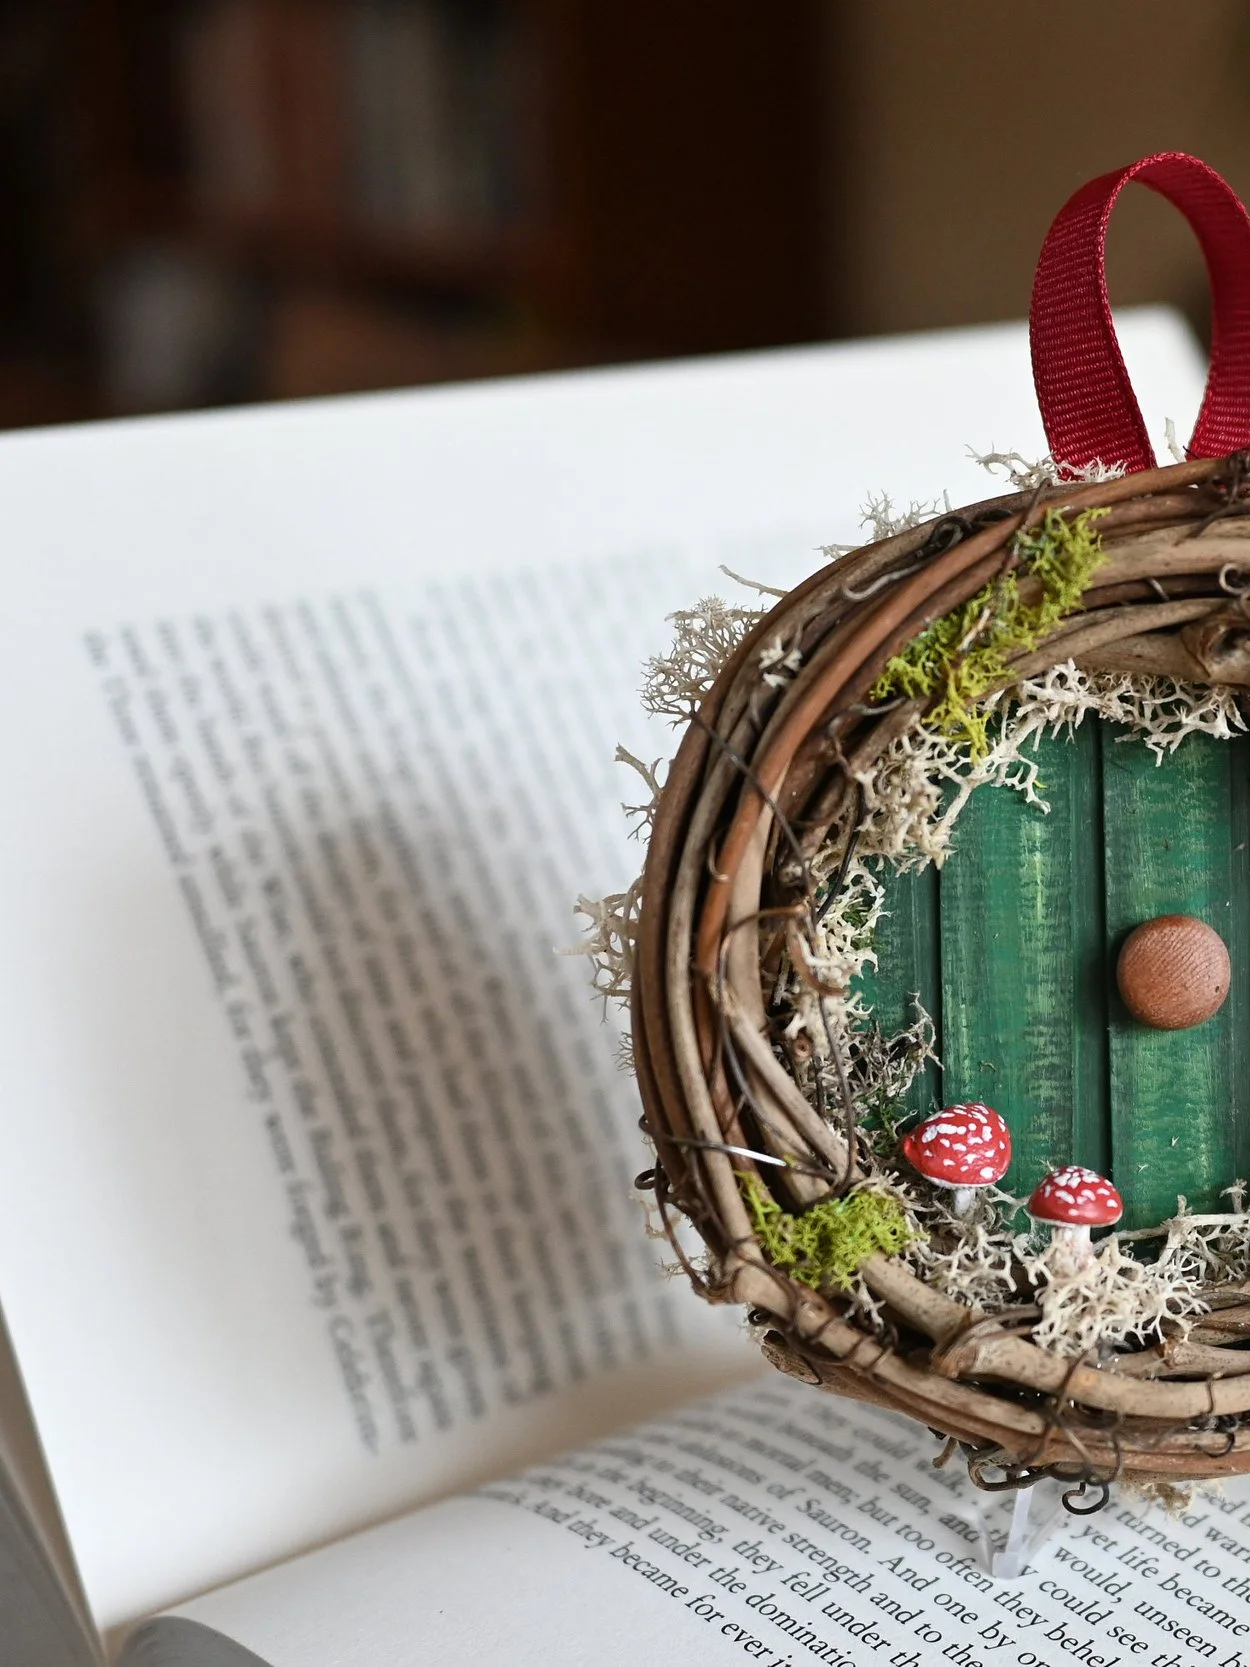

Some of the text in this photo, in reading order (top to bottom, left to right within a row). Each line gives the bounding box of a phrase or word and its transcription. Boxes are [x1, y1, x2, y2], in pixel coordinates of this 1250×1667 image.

[567, 1518, 616, 1549] they
[609, 1541, 690, 1599] became
[684, 1594, 726, 1623] for
[720, 1623, 774, 1660] ever
[609, 1504, 661, 1531] and
[647, 1527, 712, 1569] under
[707, 1567, 747, 1594] the
[627, 1479, 729, 1545] beginning,
[731, 1540, 786, 1575] they
[779, 1571, 832, 1603] fell
[820, 1601, 892, 1652] under
[719, 1494, 786, 1535] native
[782, 1533, 877, 1595] strength
[869, 1592, 926, 1625] and
[913, 1623, 943, 1644] to
[765, 1483, 807, 1501] of
[795, 1499, 873, 1555] Sauron.
[876, 1556, 941, 1592] And
[932, 1593, 980, 1625] one
[976, 1619, 1017, 1650] by
[853, 1460, 891, 1484] the
[890, 1483, 932, 1516] sun,
[1038, 1580, 1115, 1626] could
[1105, 1625, 1149, 1654] see
[856, 1496, 899, 1527] but
[895, 1525, 936, 1551] too
[935, 1551, 994, 1594] often
[992, 1591, 1050, 1630] they
[1054, 1546, 1133, 1604] would,
[1133, 1600, 1218, 1659] unseen
[1070, 1525, 1119, 1552] yet
[1116, 1546, 1160, 1579] life
[1157, 1572, 1250, 1637] became
[1114, 1510, 1202, 1562] turned
[1192, 1559, 1221, 1578] to
